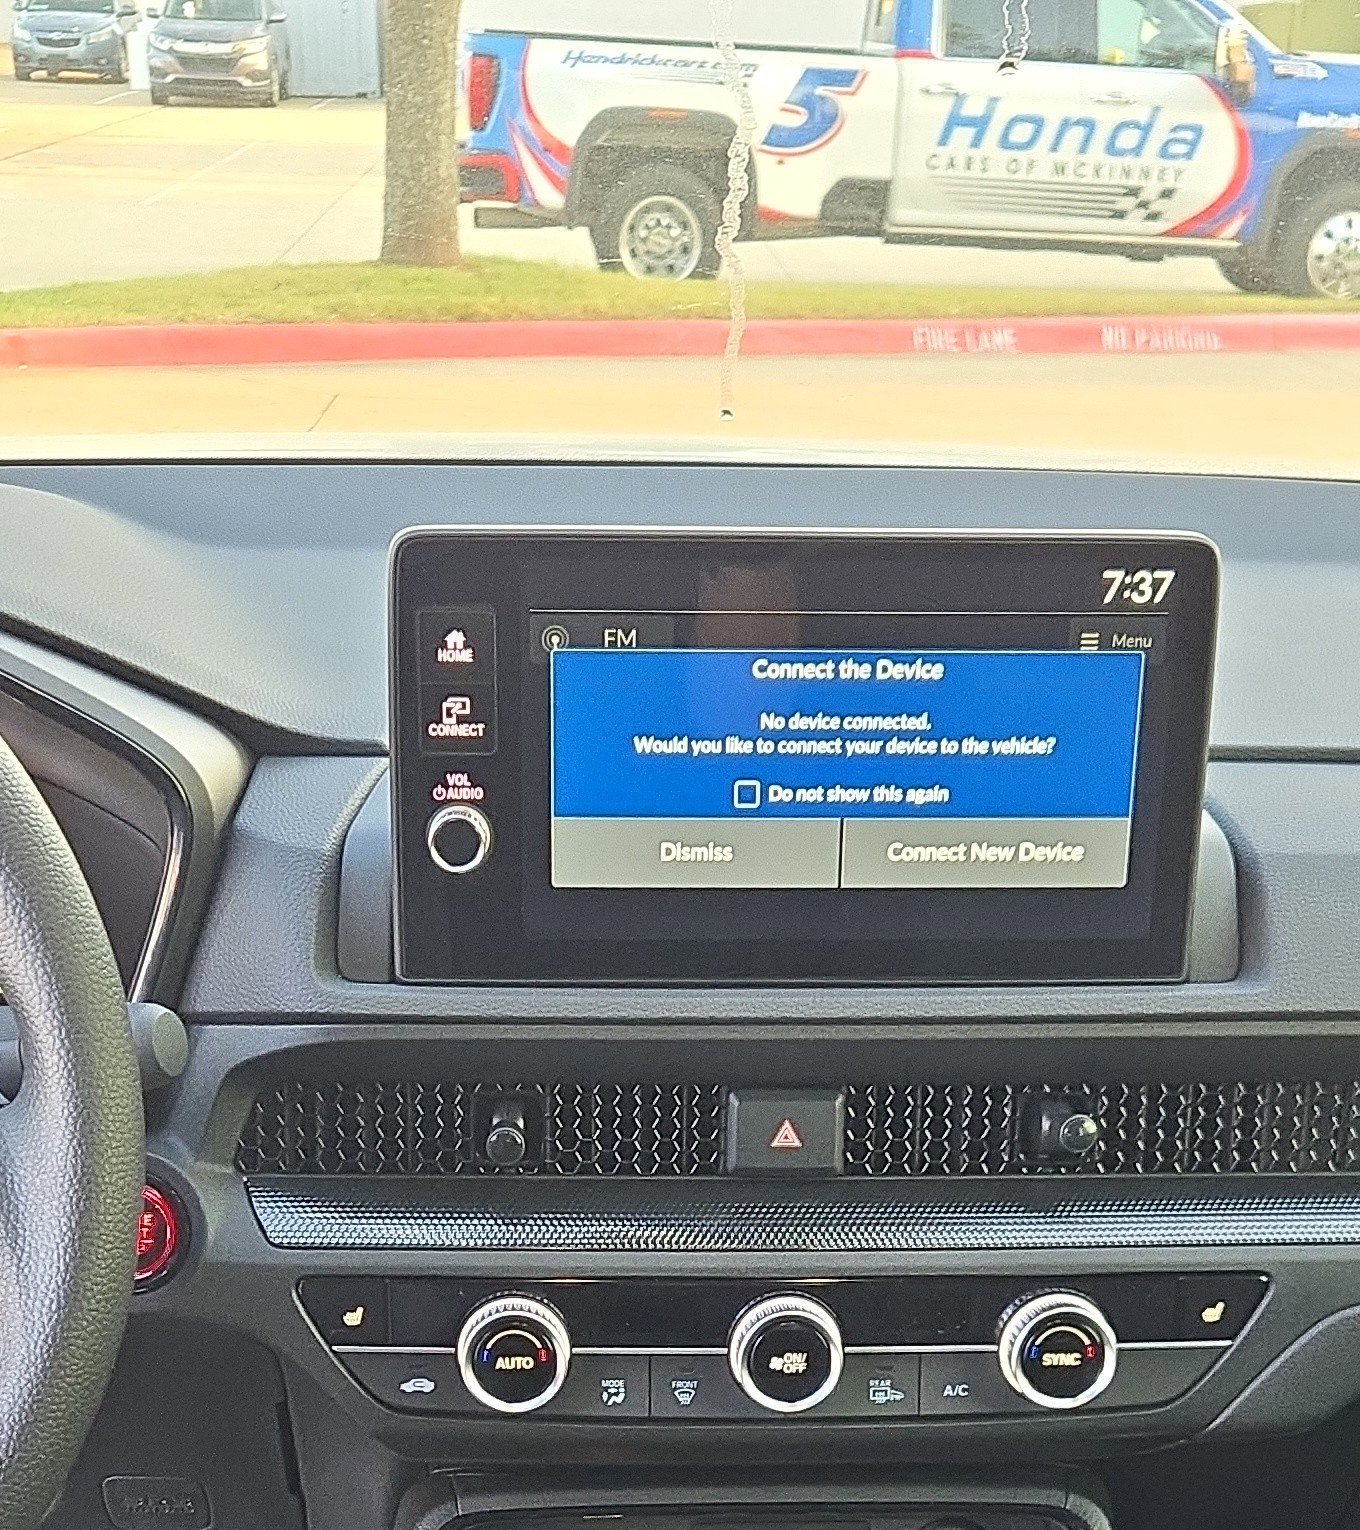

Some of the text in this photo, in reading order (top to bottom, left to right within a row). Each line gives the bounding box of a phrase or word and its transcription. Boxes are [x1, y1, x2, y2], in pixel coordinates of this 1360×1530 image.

[755, 66, 869, 157] 5
[936, 92, 1205, 161] Honda
[925, 153, 1186, 183] CARS OF MCKINNEY
[913, 325, 1018, 352] FIRE LANE
[1101, 324, 1126, 351] NO
[1101, 568, 1177, 605] 7:37
[603, 629, 637, 648] FM
[1111, 632, 1153, 650] Menu
[437, 648, 474, 663] HOME
[752, 657, 945, 681] Connect the Device
[428, 723, 486, 737] CONNECT
[760, 711, 932, 732] No device connected.
[633, 735, 1057, 757] Would you like to connect your device to the vehicle?
[446, 773, 471, 786] VOL
[446, 787, 484, 800] AUDIO
[767, 784, 950, 805] Do not show this again
[660, 841, 734, 863] Dismiss
[886, 841, 1085, 863] Connect New Device
[495, 1356, 534, 1370] AUTO
[782, 1363, 807, 1374] OFF
[1041, 1353, 1082, 1367] SYNC
[601, 1379, 625, 1388] MODE
[671, 1380, 698, 1389] FRONT
[943, 1384, 969, 1397] A/C
